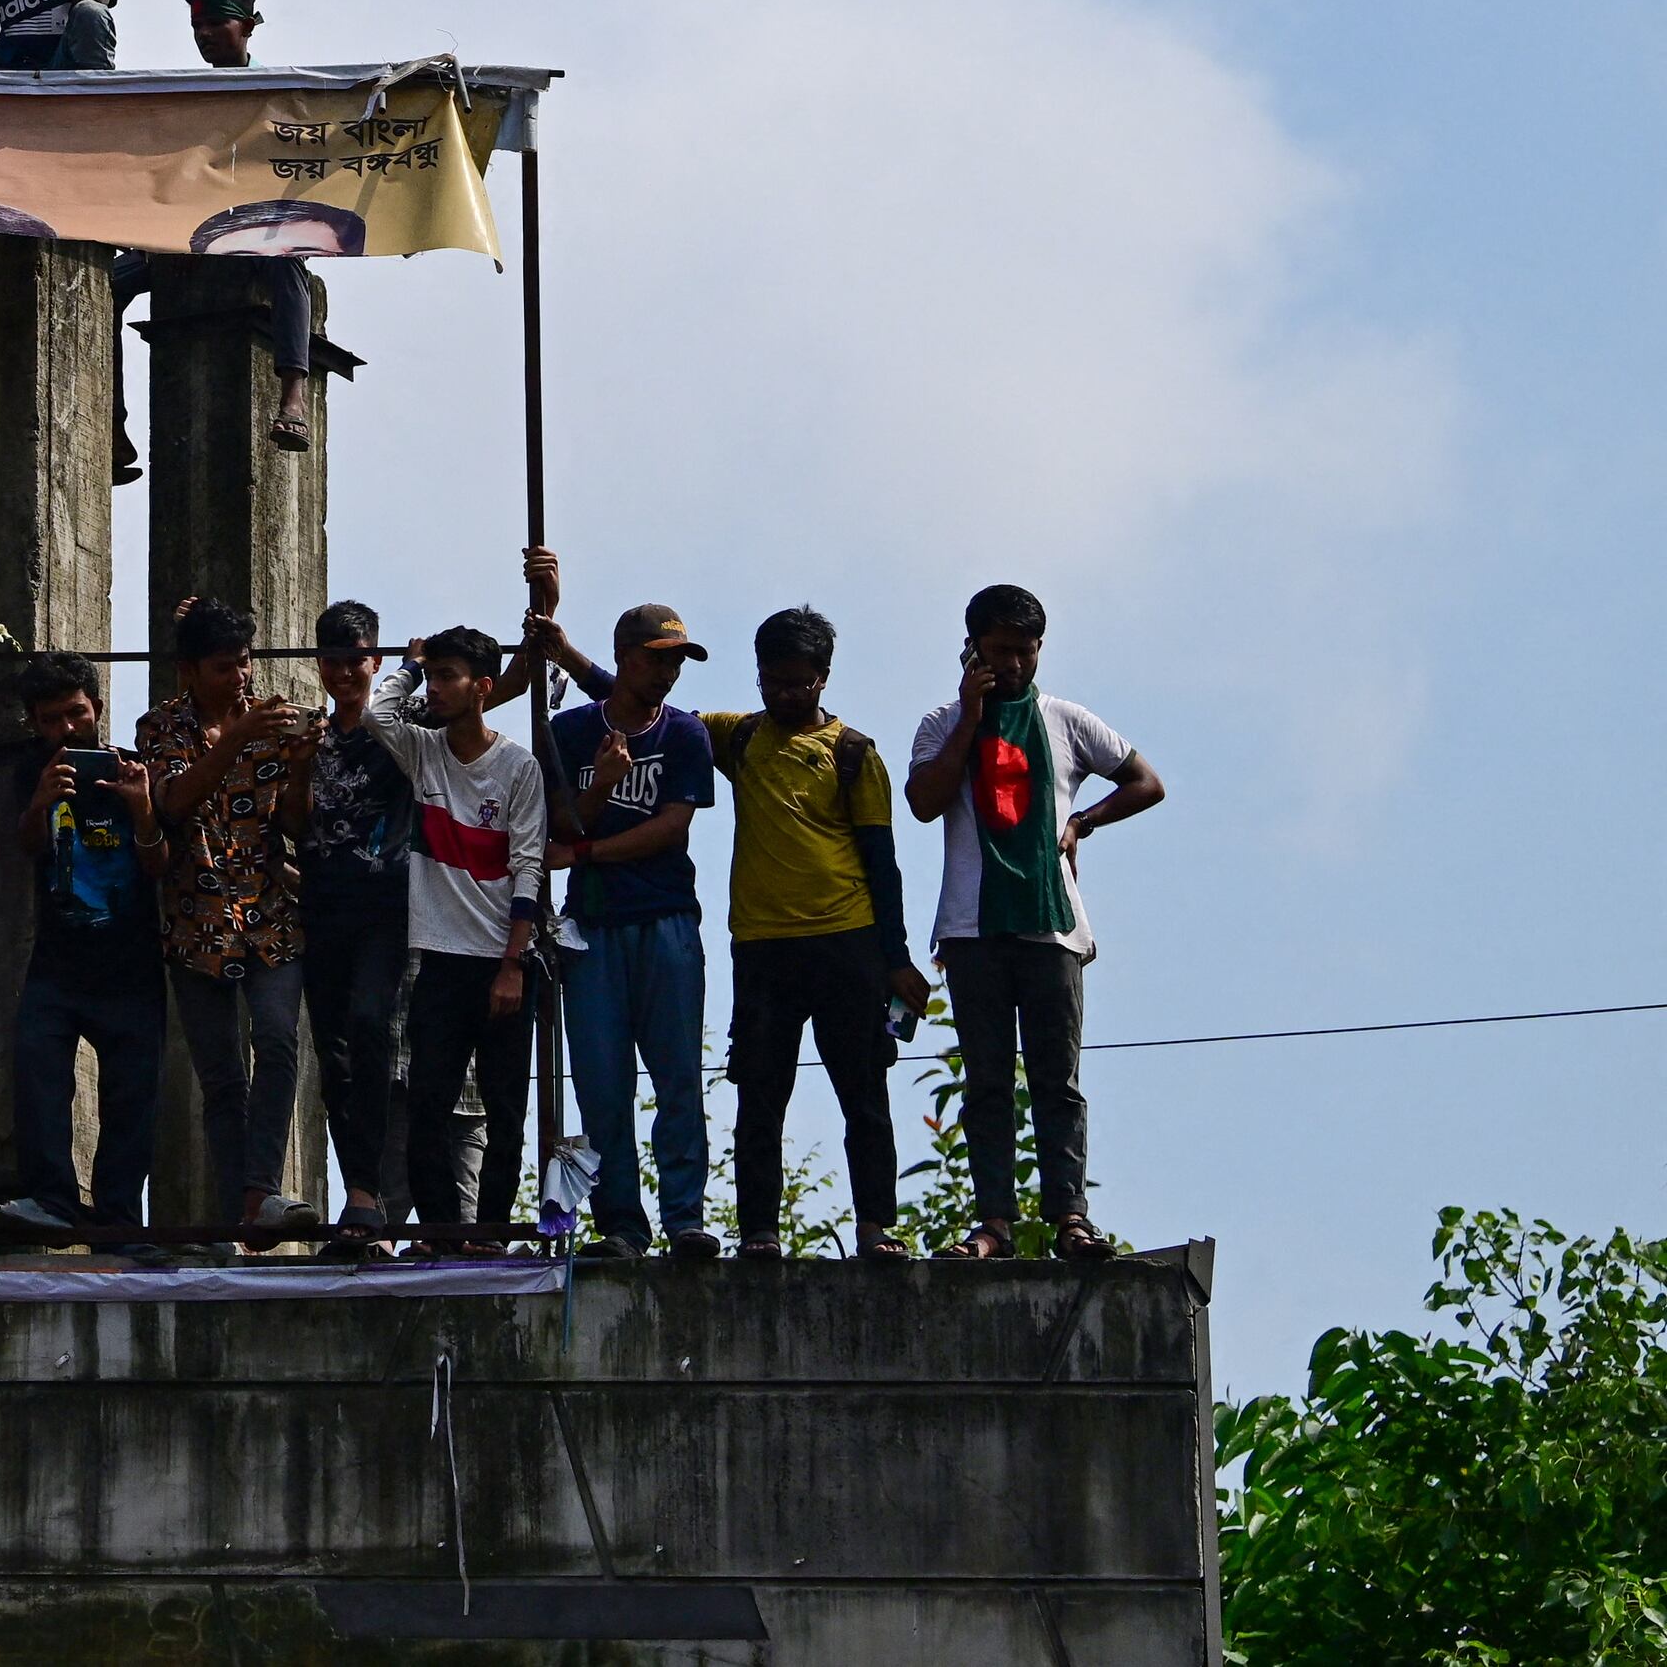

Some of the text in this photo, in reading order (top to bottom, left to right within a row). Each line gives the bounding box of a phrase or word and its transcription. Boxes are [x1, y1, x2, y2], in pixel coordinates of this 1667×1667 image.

[269, 115, 432, 148] জয় বাংলা
[268, 138, 444, 181] জয় বঙ্গবন্ধু
